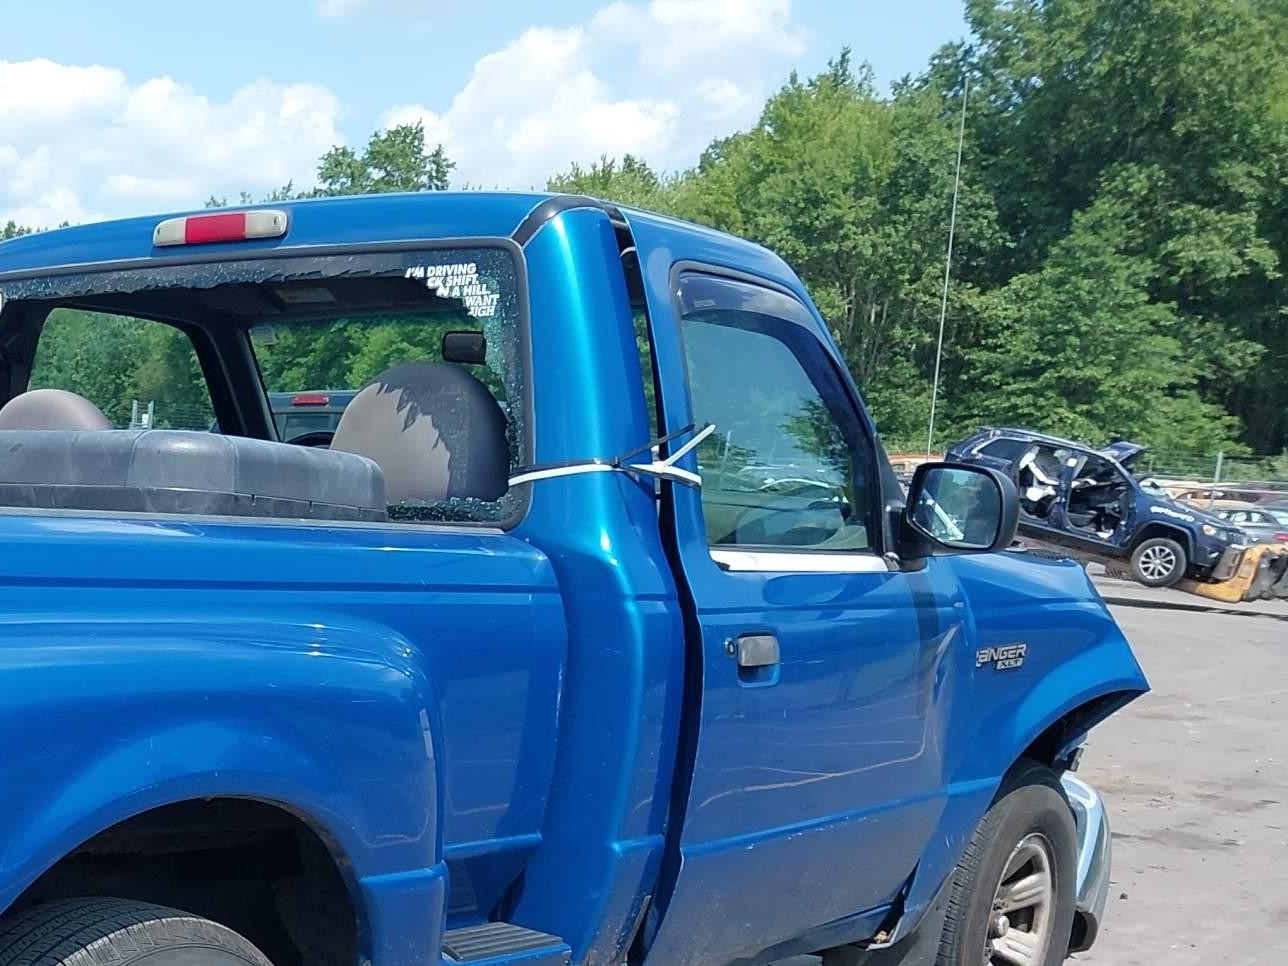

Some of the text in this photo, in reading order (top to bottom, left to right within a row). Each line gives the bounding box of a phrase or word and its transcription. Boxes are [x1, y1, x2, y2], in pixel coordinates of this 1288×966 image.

[405, 263, 477, 279] I'M DRIVING
[446, 273, 479, 287] SHIFT.
[452, 286, 461, 297] A
[462, 283, 491, 296] HILL.
[465, 294, 500, 306] WANT
